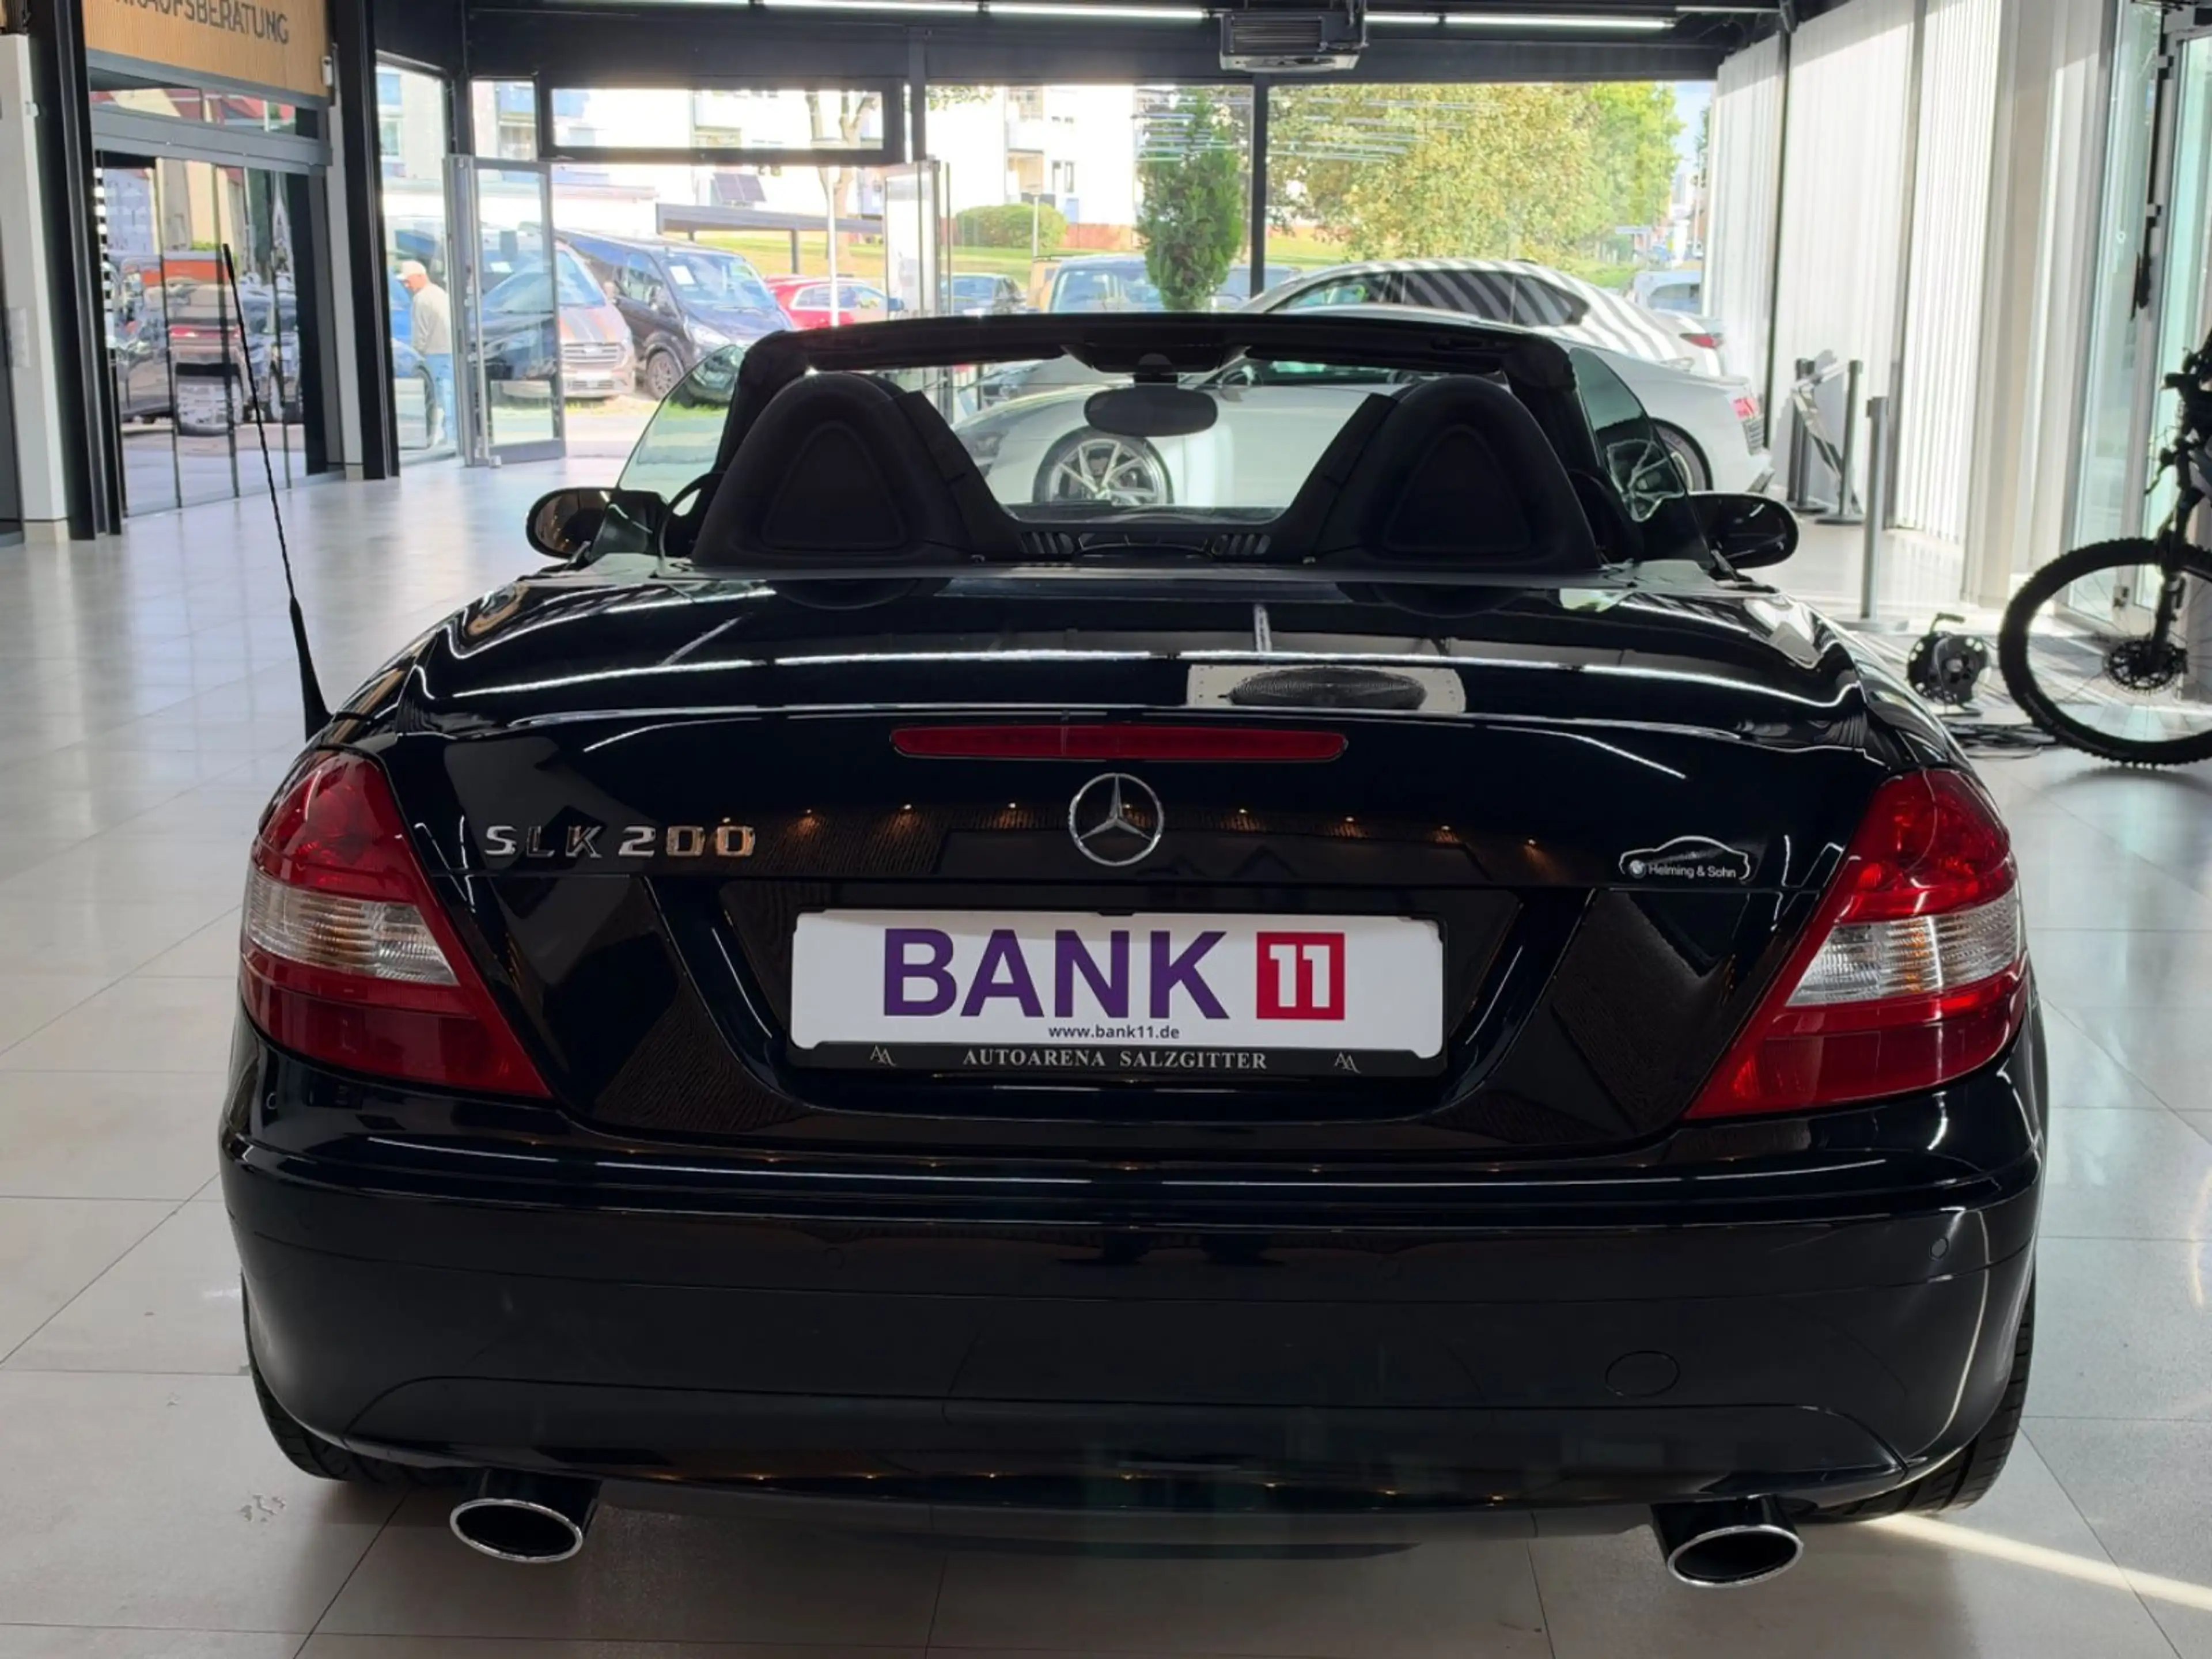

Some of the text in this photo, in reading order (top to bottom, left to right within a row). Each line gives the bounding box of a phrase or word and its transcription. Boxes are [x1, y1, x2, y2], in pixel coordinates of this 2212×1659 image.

[484, 825, 756, 858] SLK 200
[1696, 865, 1706, 877] &
[884, 929, 1331, 1019] BANK 11
[1048, 1025, 1180, 1039] www.bank11.de
[963, 1048, 1267, 1069] AUTOARENA SALZGITTER
